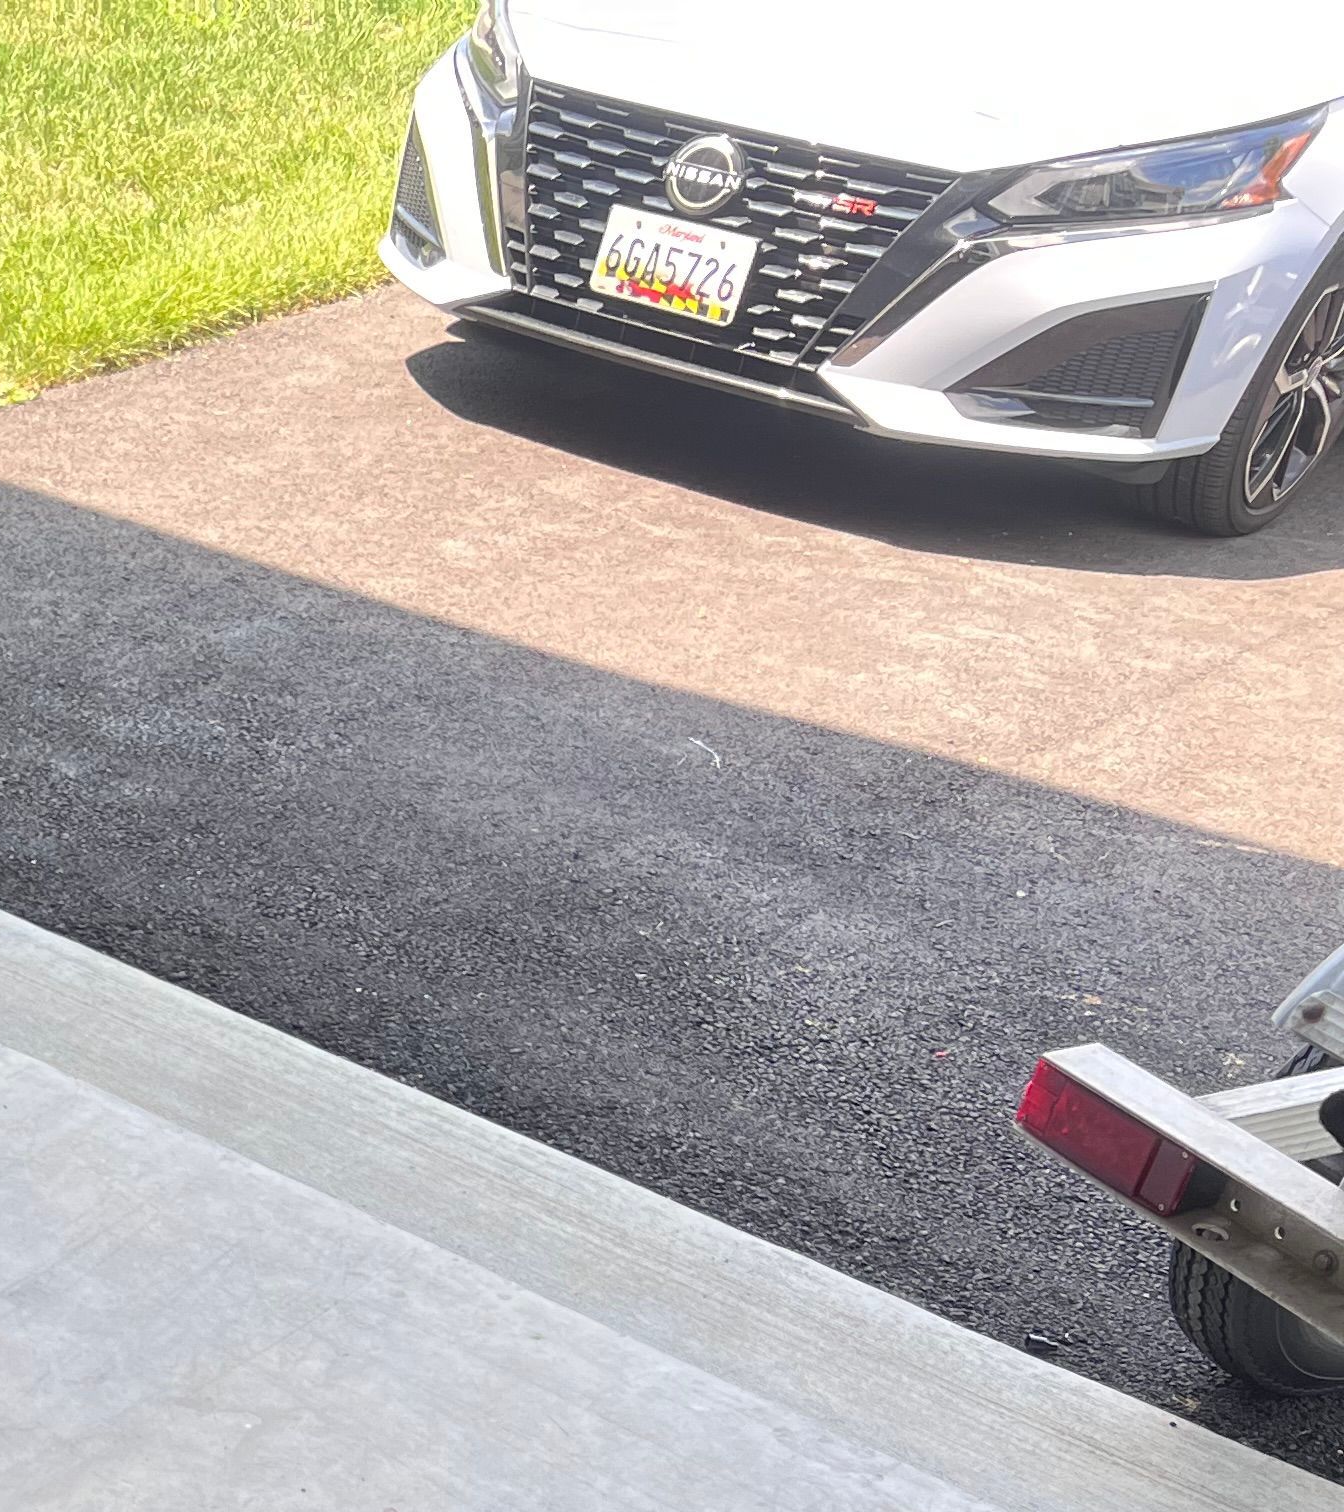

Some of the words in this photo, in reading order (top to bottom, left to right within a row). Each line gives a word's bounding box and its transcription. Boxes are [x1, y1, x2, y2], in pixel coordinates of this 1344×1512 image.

[665, 161, 741, 189] NISSAN
[832, 193, 878, 216] SR
[605, 234, 737, 302] 6GA5726
